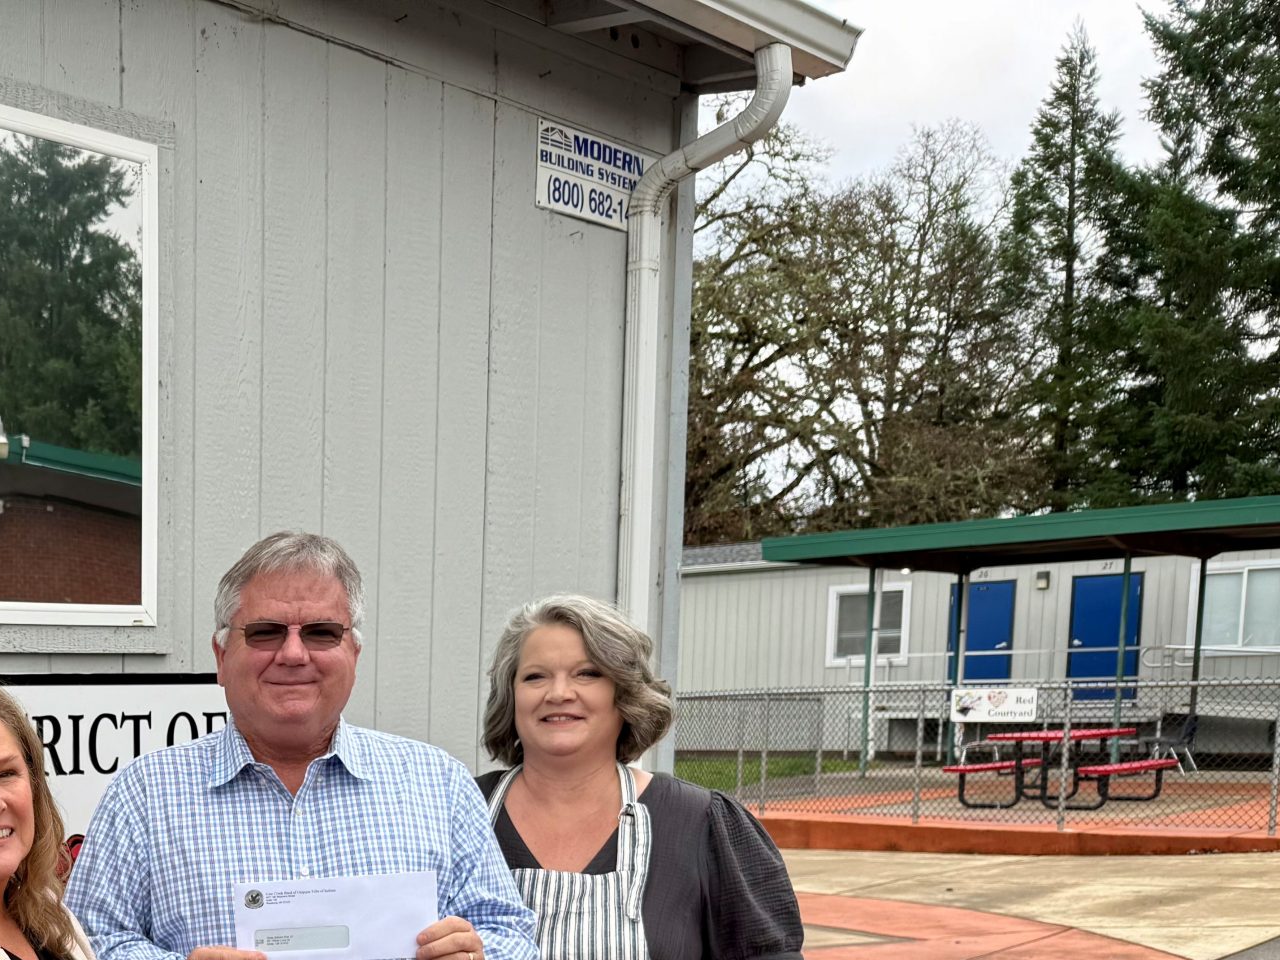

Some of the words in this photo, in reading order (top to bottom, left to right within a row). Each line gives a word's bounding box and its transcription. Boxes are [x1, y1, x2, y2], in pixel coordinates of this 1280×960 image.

[540, 149, 594, 177] BUILDING
[573, 134, 644, 177] MODERN
[547, 174, 585, 213] (800)
[987, 708, 1033, 719] Courtyard
[1016, 696, 1034, 705] Red
[31, 710, 152, 776] RICT
